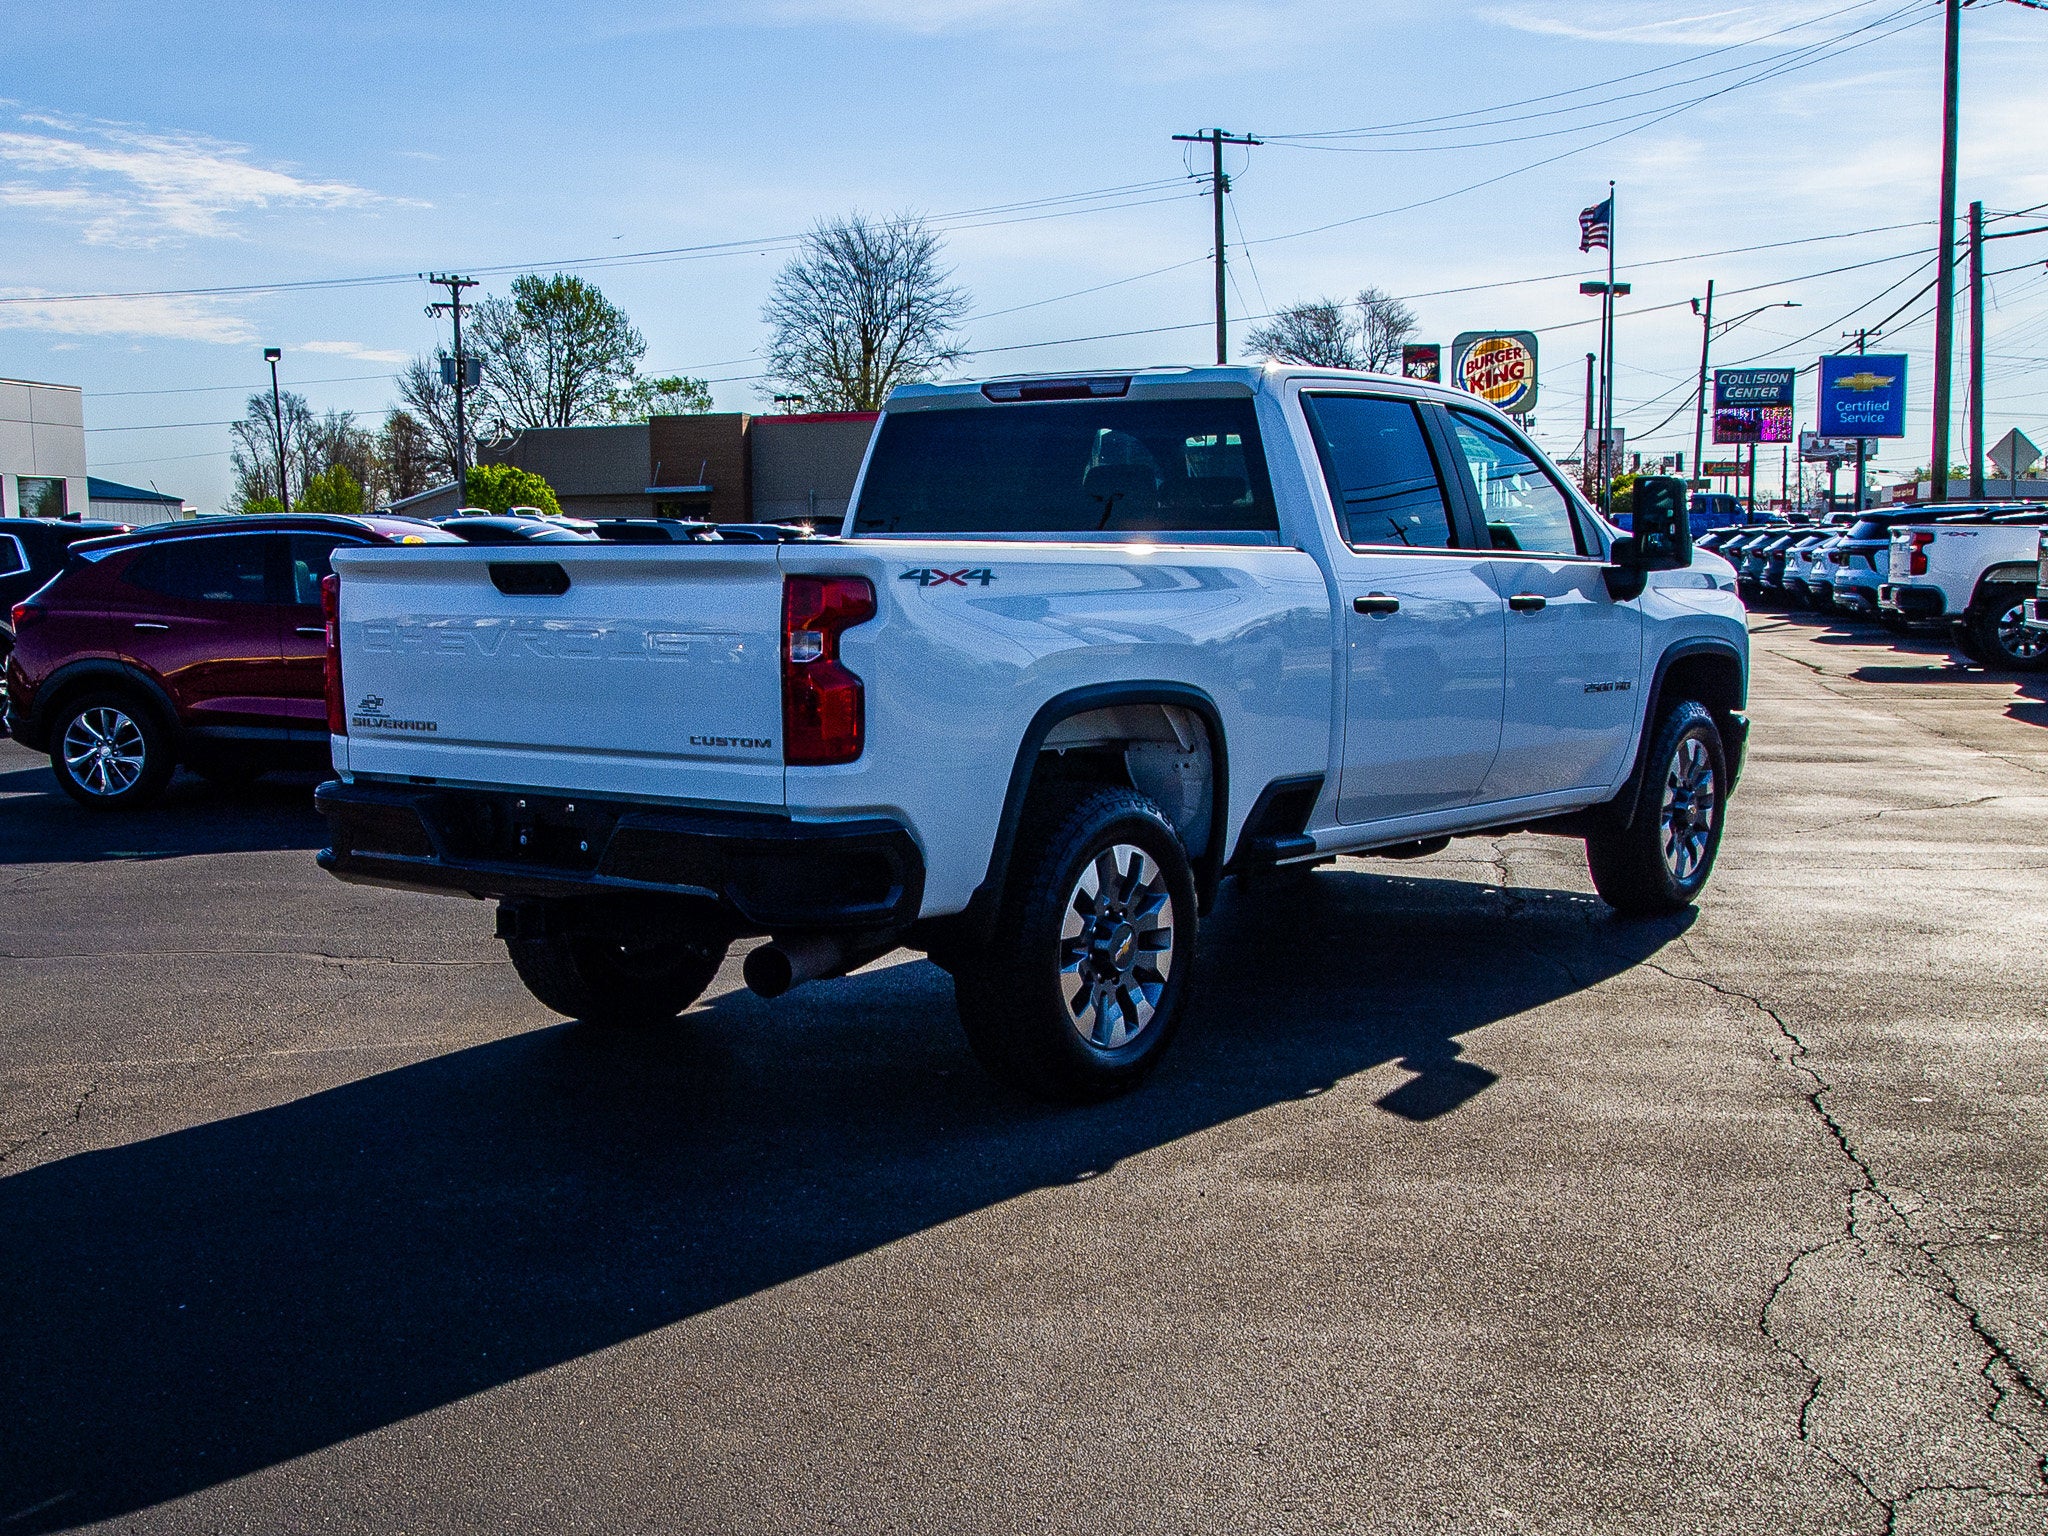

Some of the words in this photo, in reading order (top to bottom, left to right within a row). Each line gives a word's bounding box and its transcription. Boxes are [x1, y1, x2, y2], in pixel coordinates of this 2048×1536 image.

[1466, 347, 1522, 375] BURGER
[1469, 361, 1525, 394] KING
[1719, 373, 1789, 385] COLLISION
[1725, 387, 1779, 398] CENTER
[1836, 400, 1890, 412] Certified
[1840, 412, 1885, 423] Service
[362, 624, 742, 663] CHEVROLET
[1584, 682, 1614, 693] 2500
[352, 717, 438, 731] SILVERADO
[689, 736, 772, 748] CUSTOM
